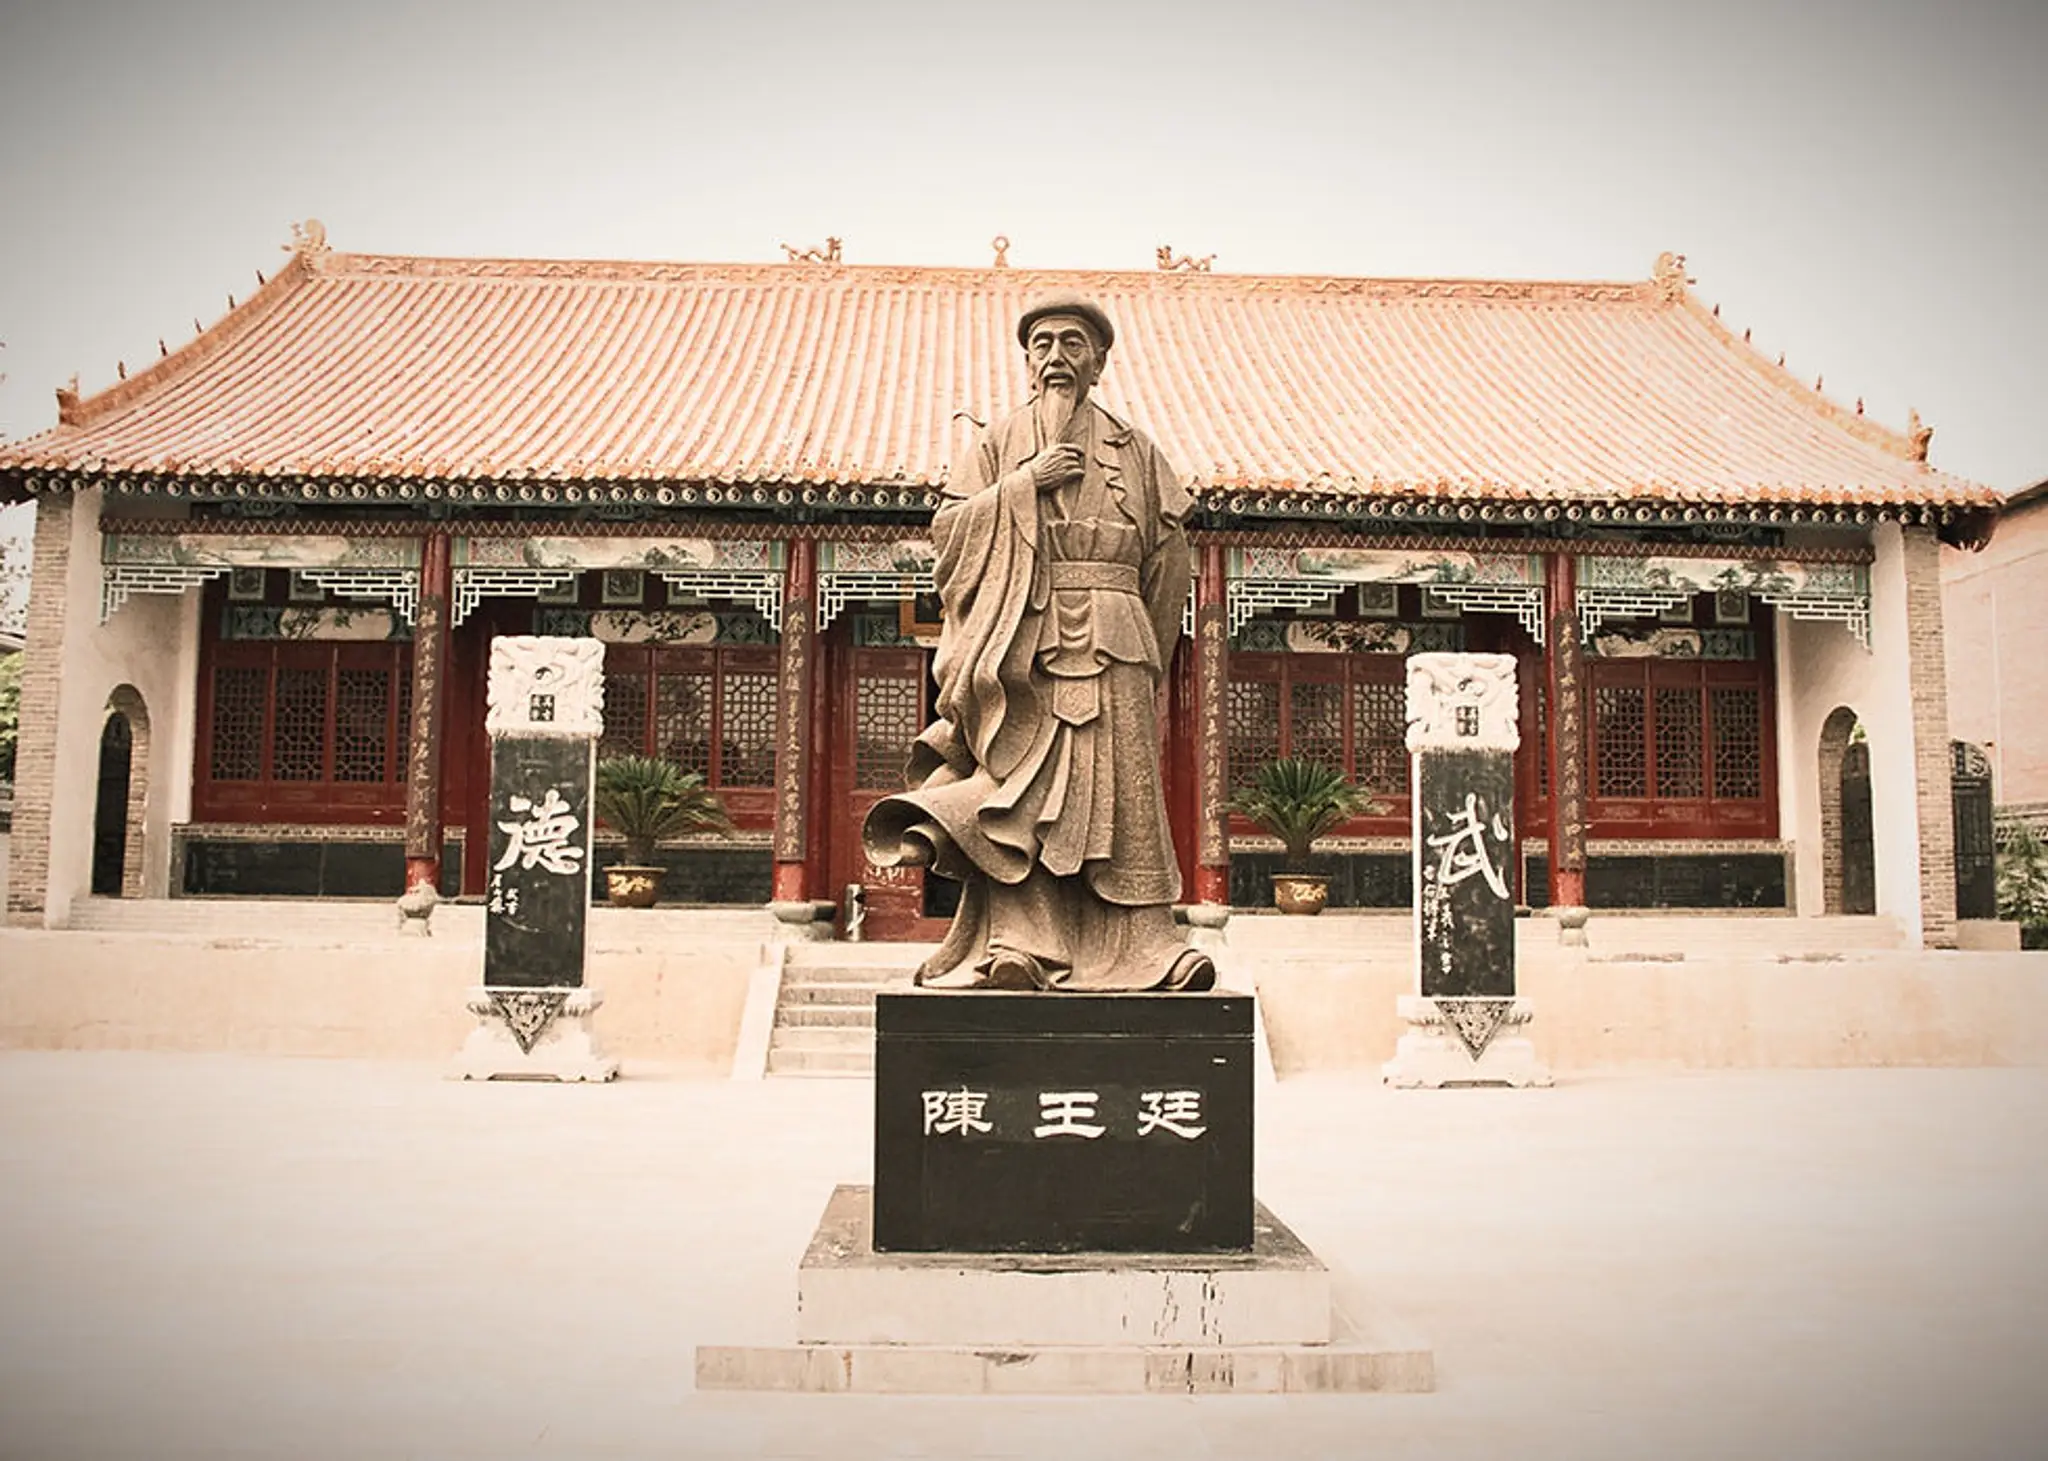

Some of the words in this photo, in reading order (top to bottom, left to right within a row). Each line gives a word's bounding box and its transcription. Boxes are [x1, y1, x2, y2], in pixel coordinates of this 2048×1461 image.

[494, 789, 584, 875] 德
[1427, 792, 1509, 899] 武
[921, 1085, 1207, 1139] 陳王廷
